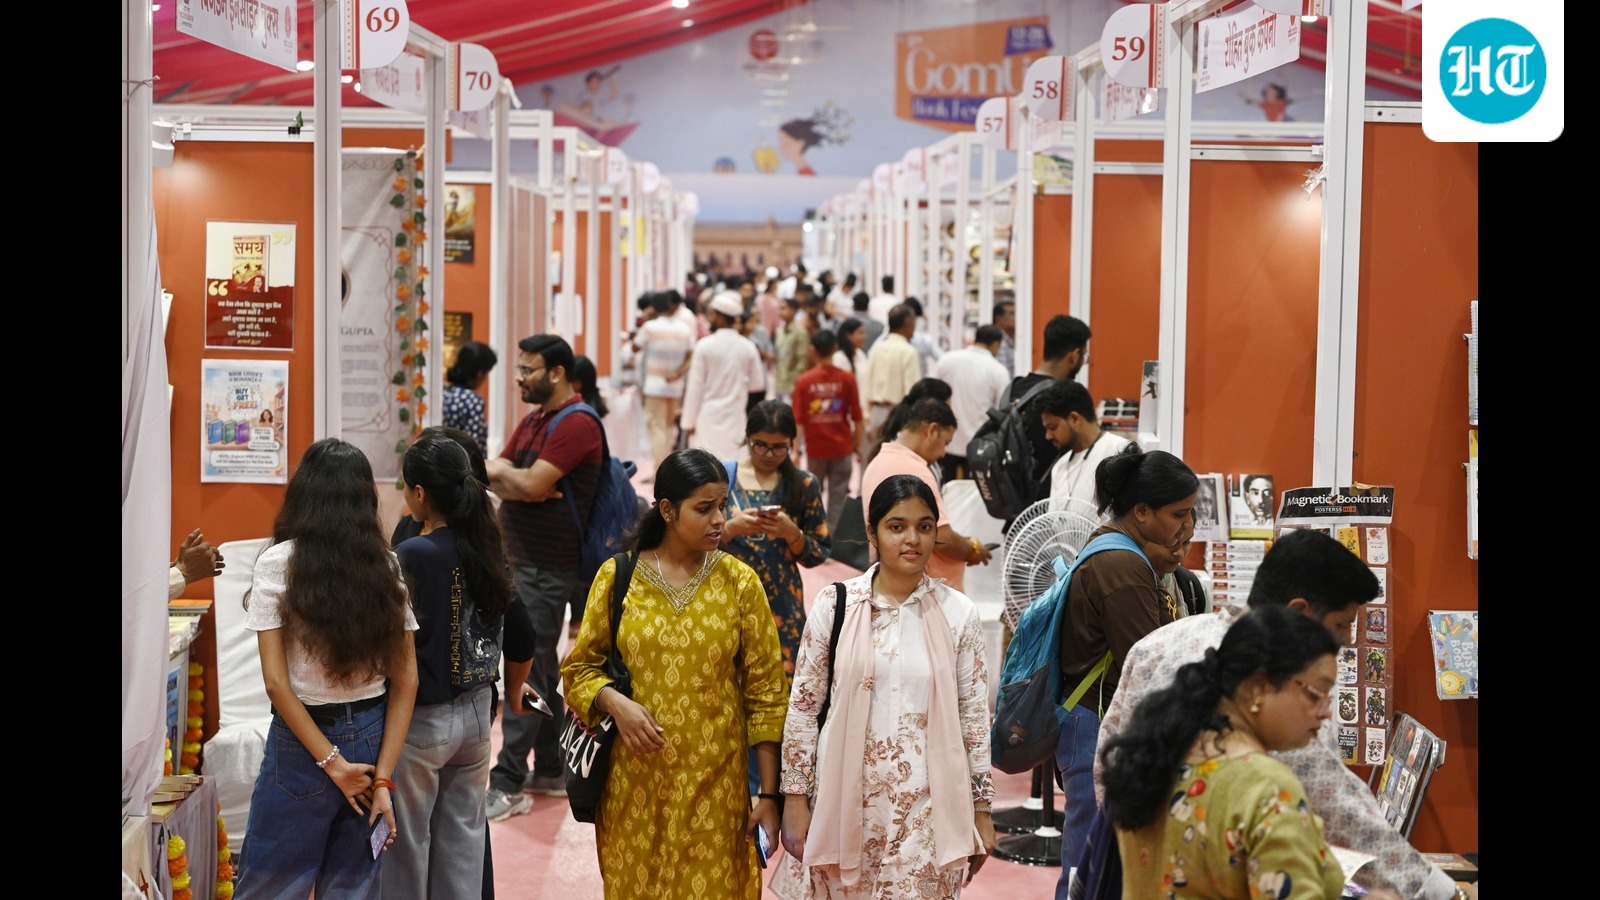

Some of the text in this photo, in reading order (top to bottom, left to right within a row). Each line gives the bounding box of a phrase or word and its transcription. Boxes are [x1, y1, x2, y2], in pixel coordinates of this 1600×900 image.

[366, 7, 400, 32] 69
[1112, 36, 1145, 61] 59
[1244, 24, 1257, 74] बुक
[466, 72, 492, 90] 70
[1032, 80, 1058, 99] 58
[983, 117, 1003, 132] 57
[234, 242, 265, 254] समय
[234, 401, 258, 410] FREE!
[1287, 494, 1389, 507] Magnetic Bookmark
[1450, 640, 1464, 668] BOOK
[1461, 642, 1476, 676] BUSY
